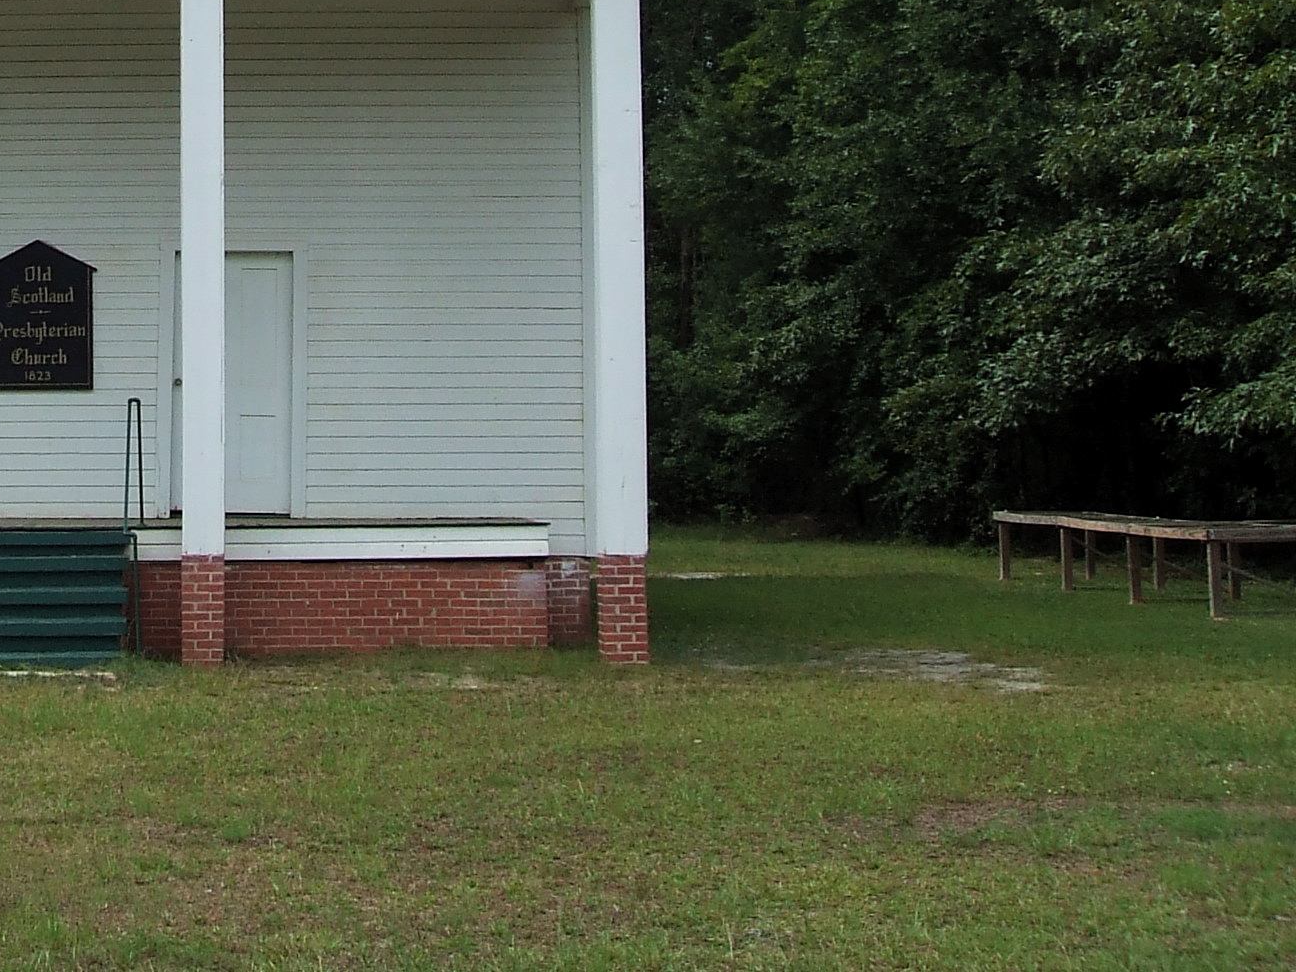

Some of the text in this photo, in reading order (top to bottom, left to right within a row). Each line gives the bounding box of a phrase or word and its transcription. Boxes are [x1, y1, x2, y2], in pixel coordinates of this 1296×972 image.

[24, 266, 52, 282] Old
[8, 285, 74, 307] Scotland
[11, 347, 67, 365] Church
[24, 371, 51, 381] 1823
